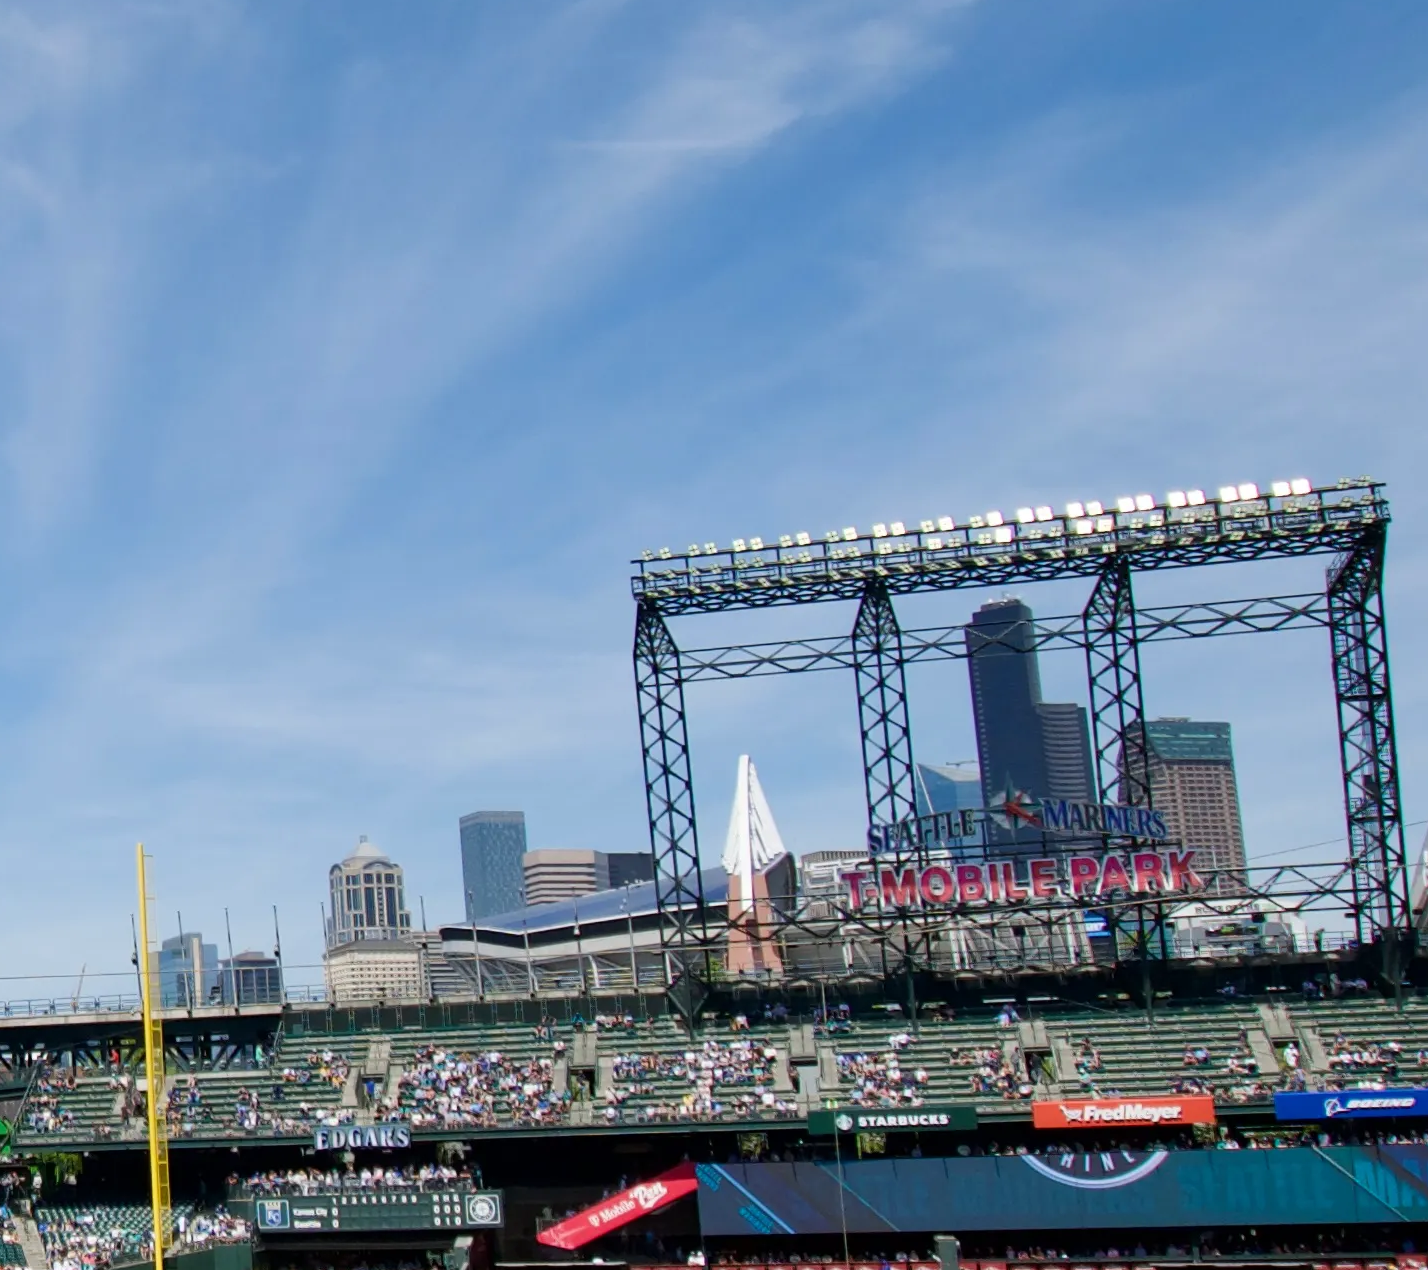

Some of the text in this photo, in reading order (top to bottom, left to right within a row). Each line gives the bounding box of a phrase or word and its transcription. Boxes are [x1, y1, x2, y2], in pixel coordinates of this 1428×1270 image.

[867, 797, 1169, 854] SEATTLE MARINERS
[842, 849, 1204, 910] T-MOBILE PARK
[1346, 1097, 1415, 1110] BOEING
[857, 1113, 949, 1129] STARBUCKS
[316, 1128, 410, 1149] EDGARS
[600, 1200, 635, 1223] Mobile
